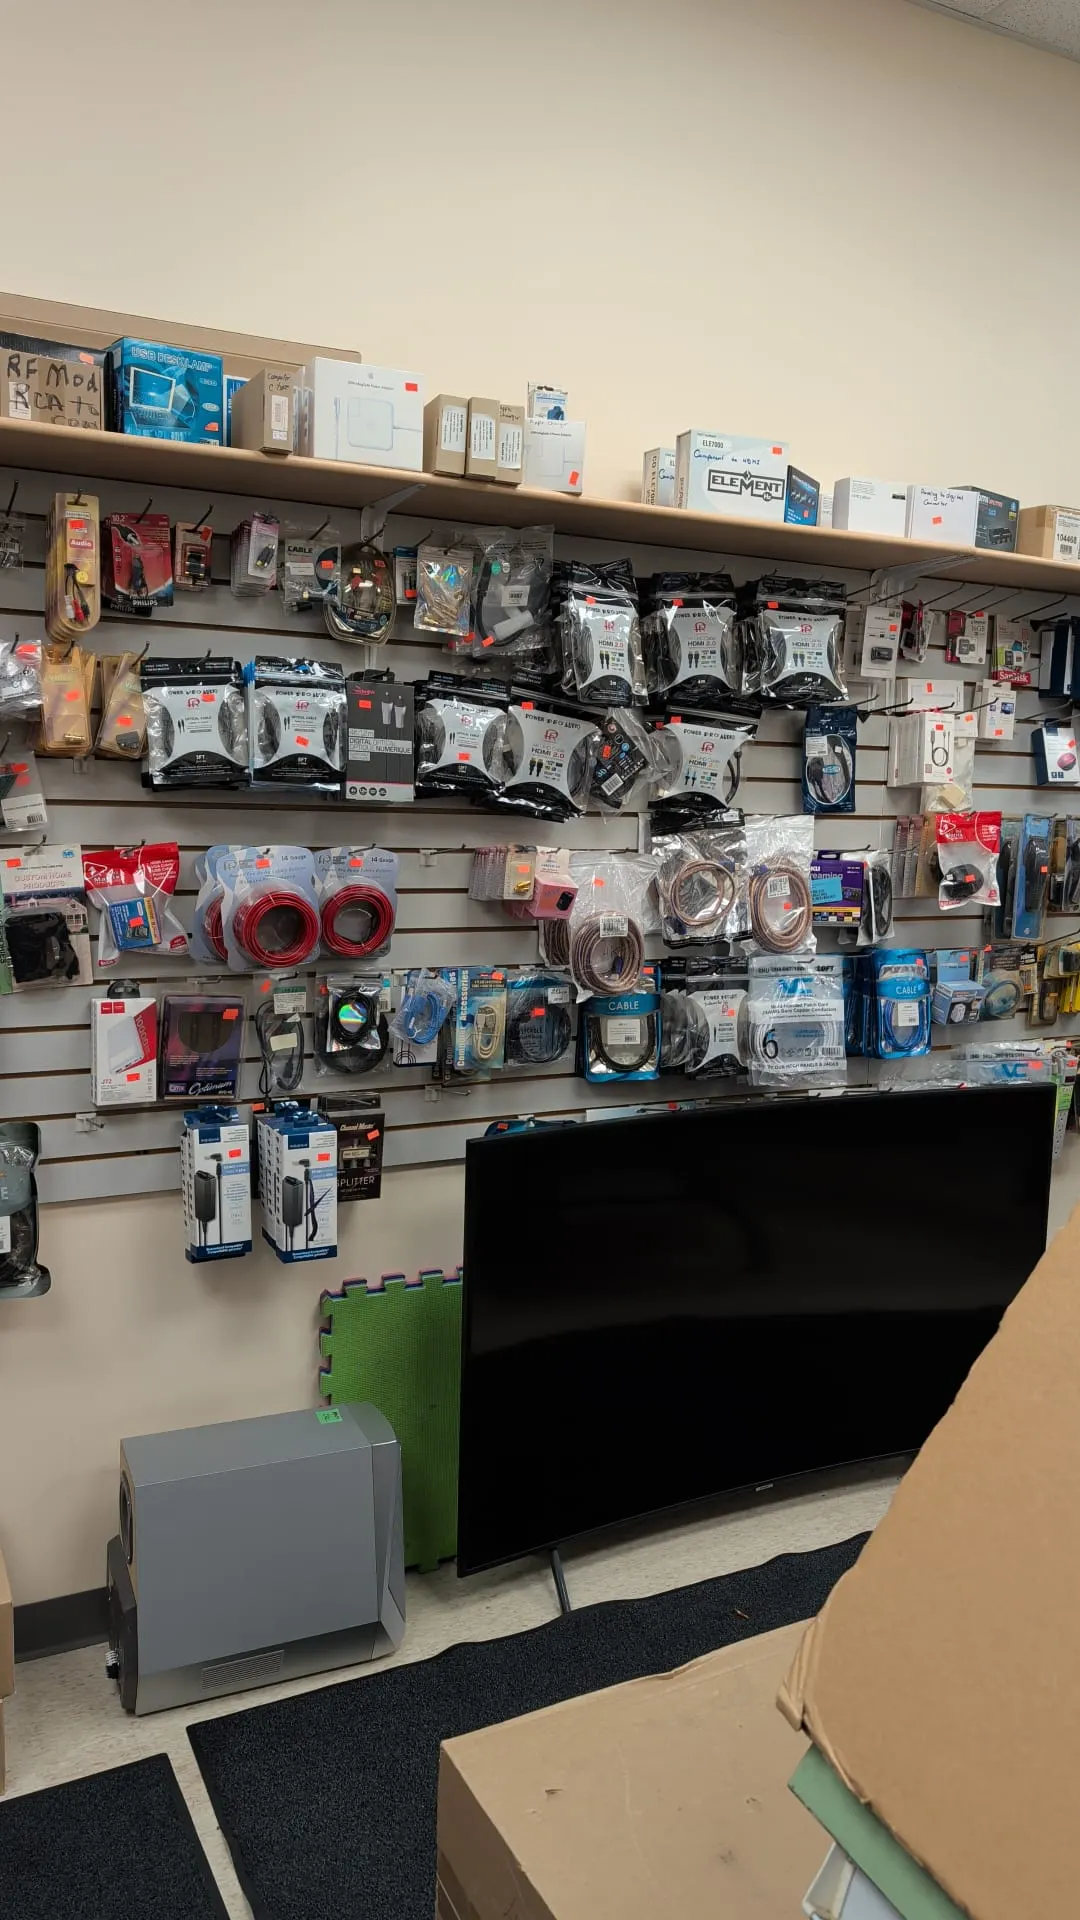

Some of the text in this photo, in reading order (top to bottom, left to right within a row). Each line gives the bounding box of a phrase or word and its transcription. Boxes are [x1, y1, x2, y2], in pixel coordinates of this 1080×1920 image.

[131, 346, 156, 361] USB
[7, 353, 98, 392] RF Mod
[15, 383, 64, 411] RCA
[702, 439, 724, 449] ELE7000
[711, 475, 782, 492] ELEMENT
[70, 539, 92, 547] Audio
[287, 545, 313, 554] CABLE
[599, 640, 614, 648] HDMI
[349, 738, 372, 746] DIGITAL
[531, 747, 565, 759] HDMI 2.0
[48, 871, 73, 880] HOME
[459, 970, 469, 1021] Accessories
[895, 985, 917, 995] CABLE
[608, 1000, 639, 1011] CABLE
[1001, 1063, 1028, 1077] VC
